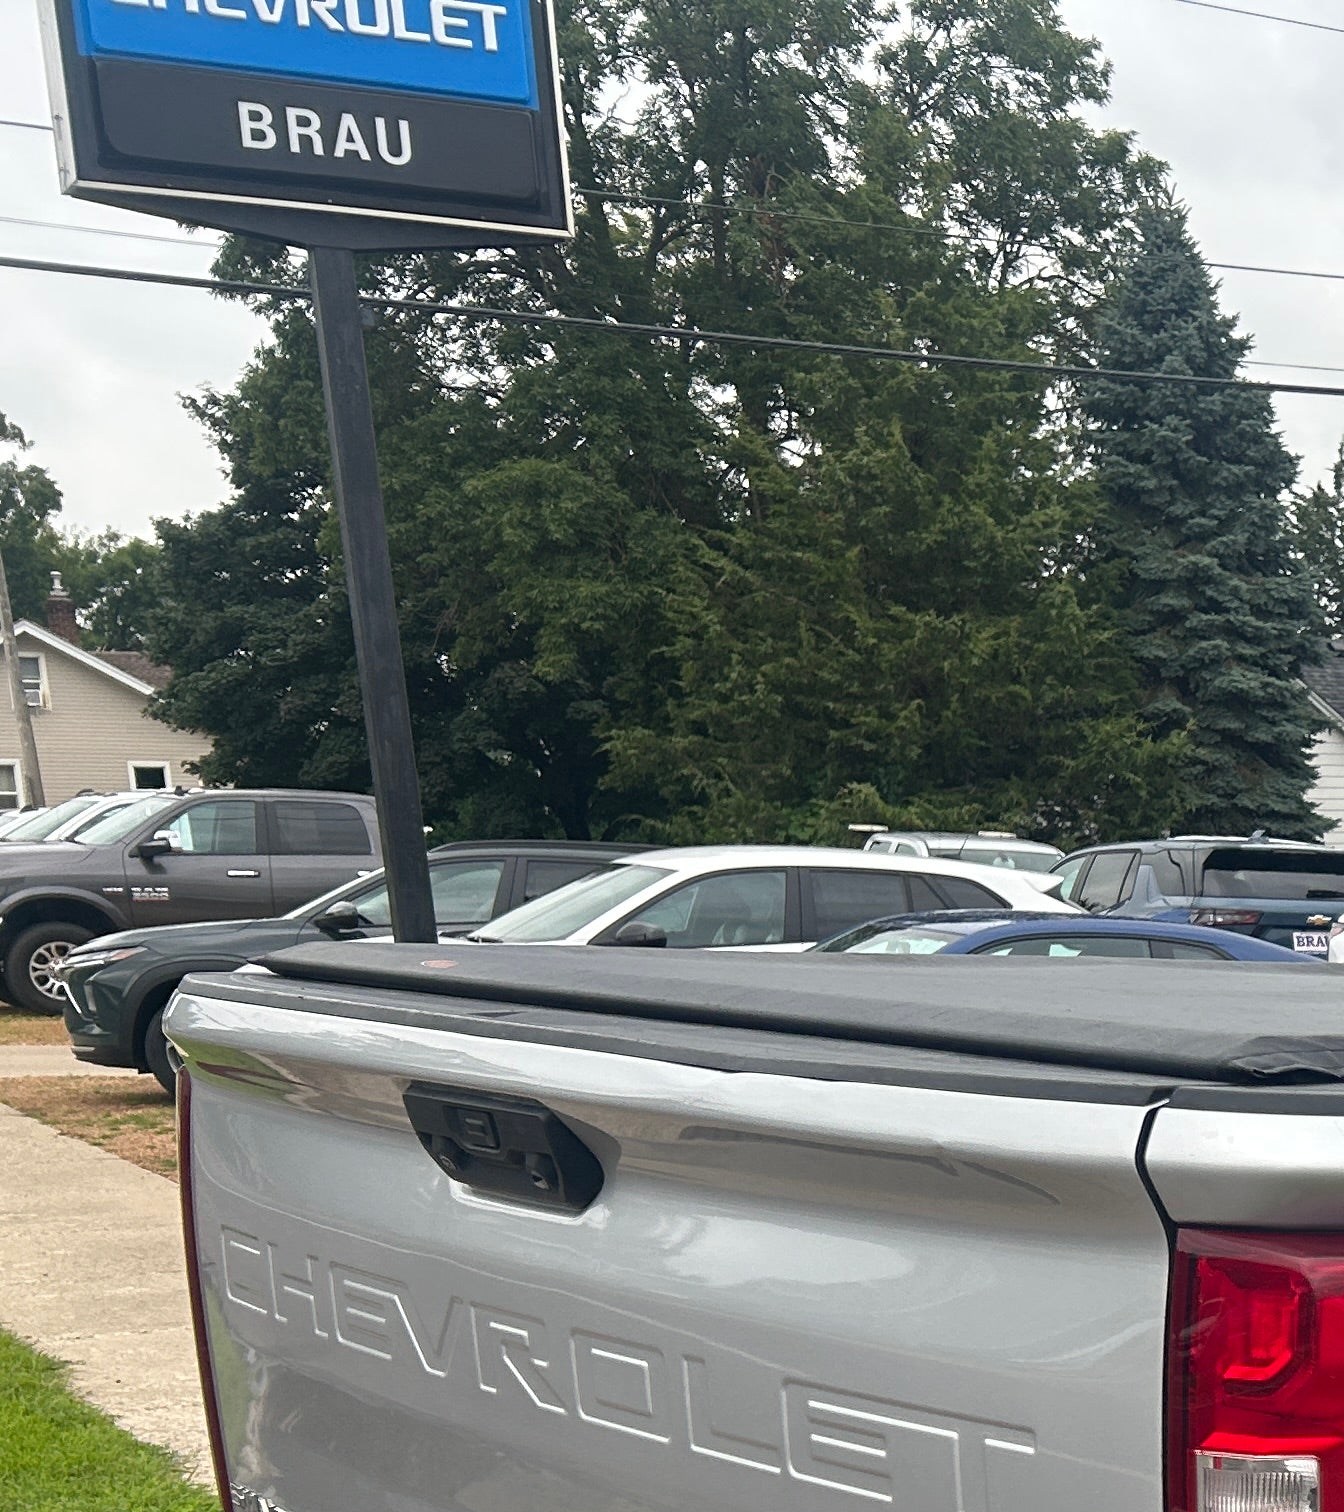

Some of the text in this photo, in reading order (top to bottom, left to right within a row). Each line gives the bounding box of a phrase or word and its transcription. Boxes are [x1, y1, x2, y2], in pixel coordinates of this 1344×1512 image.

[110, 0, 507, 52] VROLET
[236, 100, 412, 166] BRAU
[1296, 935, 1329, 947] BRA
